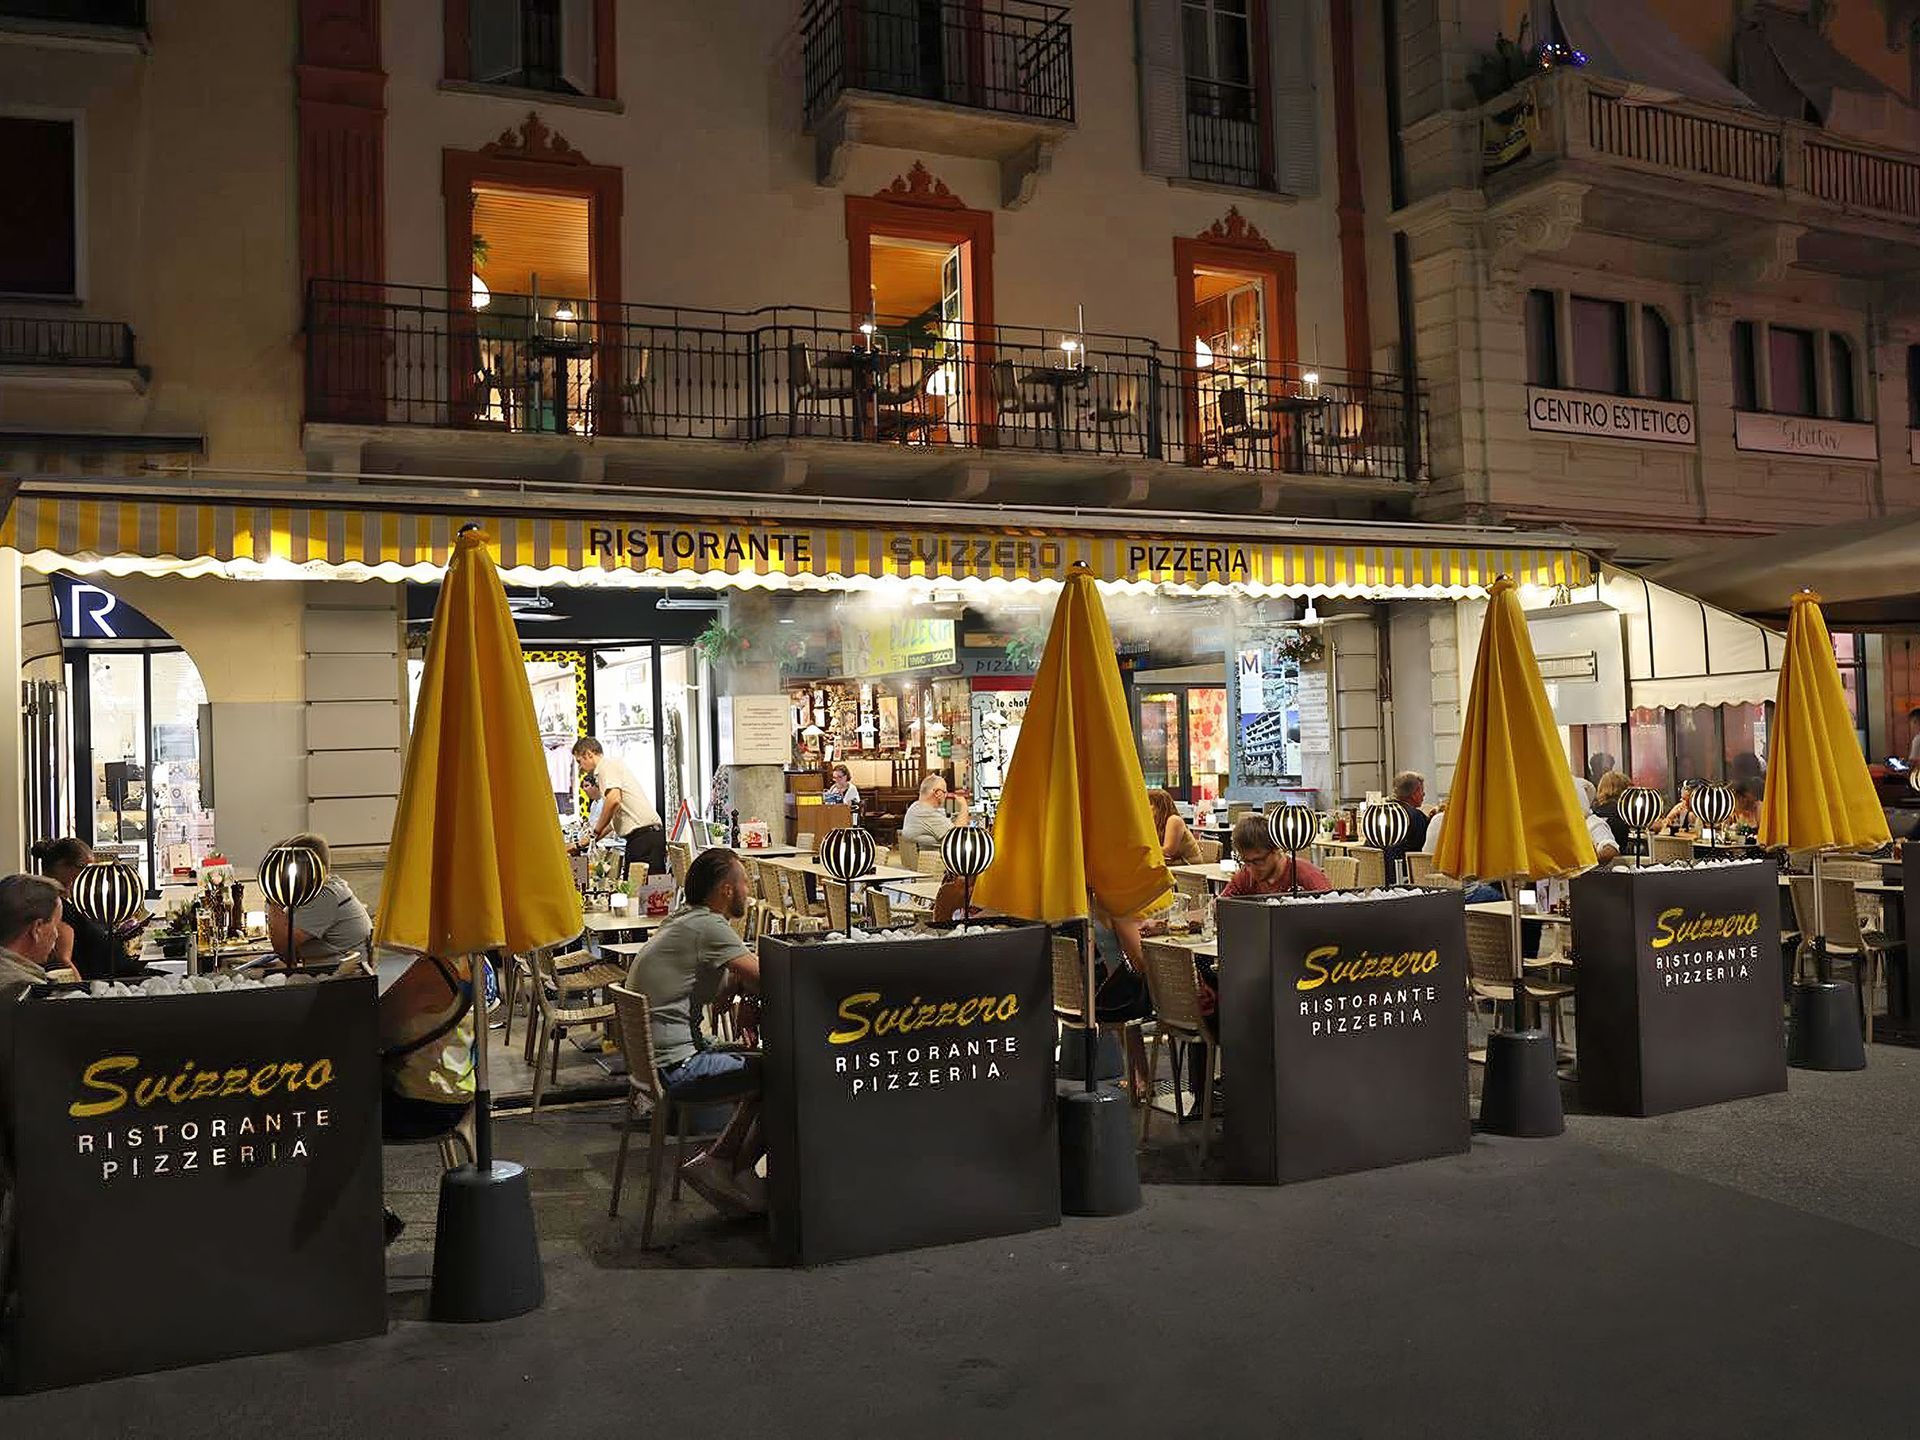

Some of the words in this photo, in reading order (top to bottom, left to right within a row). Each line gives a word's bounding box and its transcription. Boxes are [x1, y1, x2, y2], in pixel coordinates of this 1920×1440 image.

[1534, 397, 1607, 427] CENTRO
[1613, 405, 1691, 435] ESTETICO
[590, 528, 811, 562] RISTORANTE
[890, 537, 1060, 569] SVIZZERO
[1130, 547, 1248, 573] PIZZERIA
[1241, 654, 1259, 675] M
[1651, 907, 1760, 948] Svizzero
[1296, 946, 1440, 990] Svizzero
[1656, 945, 1758, 969] RISTORANTE
[1665, 964, 1748, 987] PIZZERIA
[828, 992, 1019, 1044] Svizzero
[1300, 987, 1435, 1016] RISTORANTE
[1312, 1008, 1422, 1036] PIZZERIA
[835, 1037, 1016, 1073] RISTORANTE
[68, 1056, 335, 1118] Svizzero
[853, 1062, 1000, 1095] PIZZERIA
[78, 1109, 329, 1153] RISTORANTE
[103, 1140, 308, 1180] PIZZERIA
